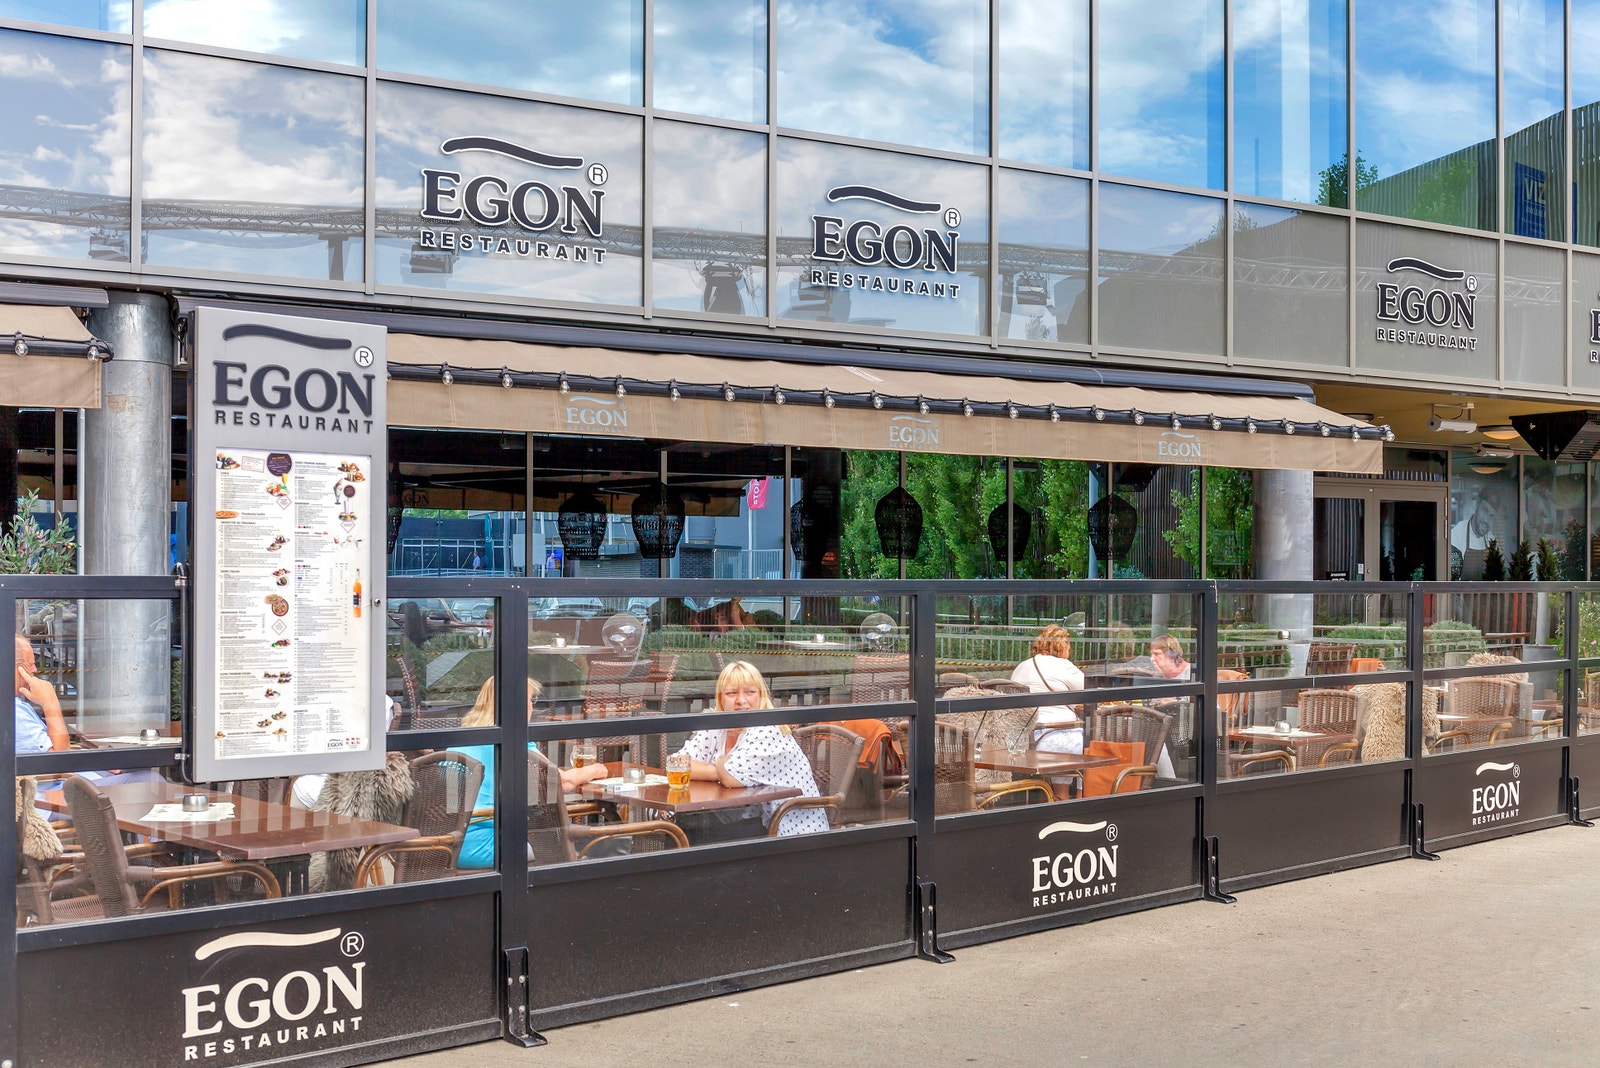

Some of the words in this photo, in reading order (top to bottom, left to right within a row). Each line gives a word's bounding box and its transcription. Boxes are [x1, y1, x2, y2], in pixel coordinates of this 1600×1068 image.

[422, 169, 605, 236] EGON
[421, 231, 606, 264] RESTAURANT
[812, 215, 960, 274] EGON
[812, 270, 960, 298] RESTAURANT
[1377, 282, 1476, 329] EGON
[1377, 328, 1477, 350] RESTAURANT
[212, 360, 375, 417] EGON
[215, 410, 373, 434] RESTAURANT
[567, 407, 627, 427] EGON
[889, 425, 939, 444] EGON
[1158, 440, 1201, 457] EGON
[1472, 781, 1521, 814] EGON
[1473, 809, 1519, 826] RESTAURANT
[1032, 845, 1119, 892] EGON
[1033, 883, 1116, 907] RESTAURANT
[182, 962, 366, 1038] EGON
[184, 1016, 363, 1061] RESTAURANT
